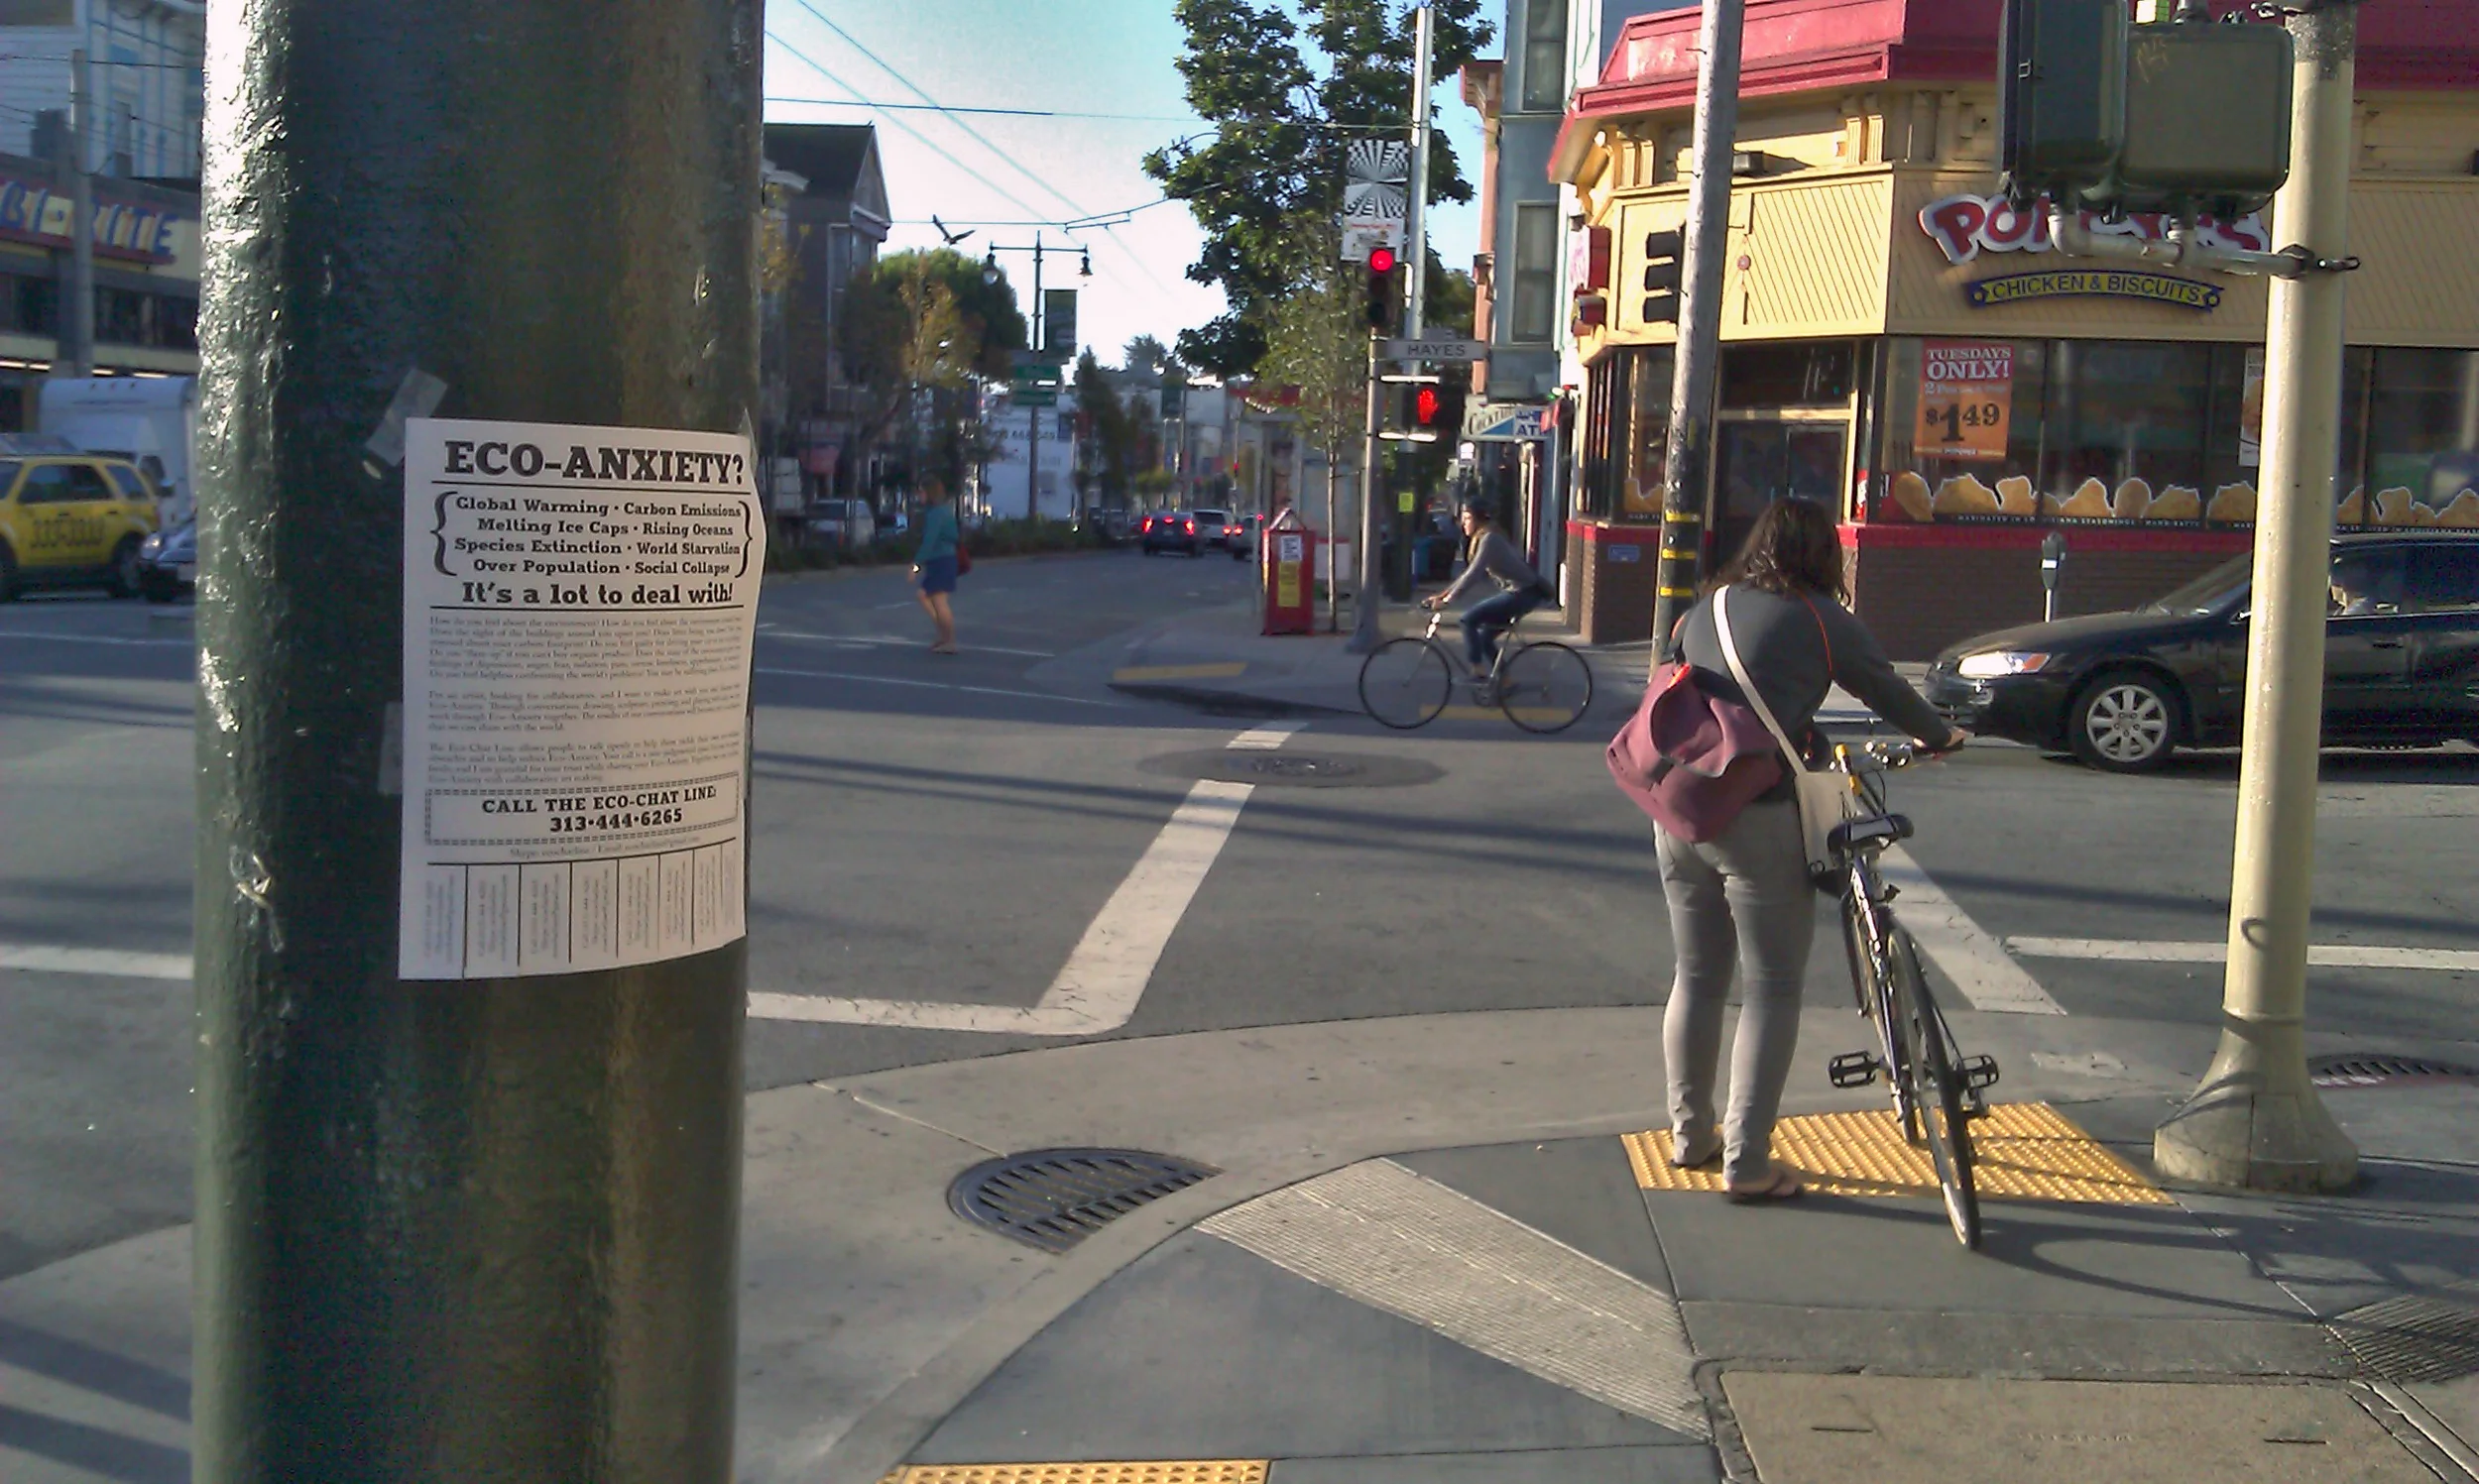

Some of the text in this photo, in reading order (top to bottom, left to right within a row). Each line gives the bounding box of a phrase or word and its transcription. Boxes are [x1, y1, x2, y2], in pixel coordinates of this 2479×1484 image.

[1992, 276, 2203, 303] CHICKEN & BISCUITS
[1407, 344, 1466, 357] HAYES
[1927, 348, 2011, 360] TUESDAYS
[1927, 360, 2010, 381] ONLY!
[443, 440, 745, 486] ECO-ANXIETY?
[456, 497, 741, 517] Global Warming Carbon Emissions
[477, 518, 734, 538] Melting Ice Caps Rising Oceans
[454, 538, 741, 555] Species Extinction World Starvation
[473, 559, 731, 577] Over Population Social Collapse
[462, 582, 734, 604] It's a lot to deal with!
[482, 799, 537, 814] CALL
[545, 797, 587, 812] THE
[592, 790, 680, 811] ECO-CHAT
